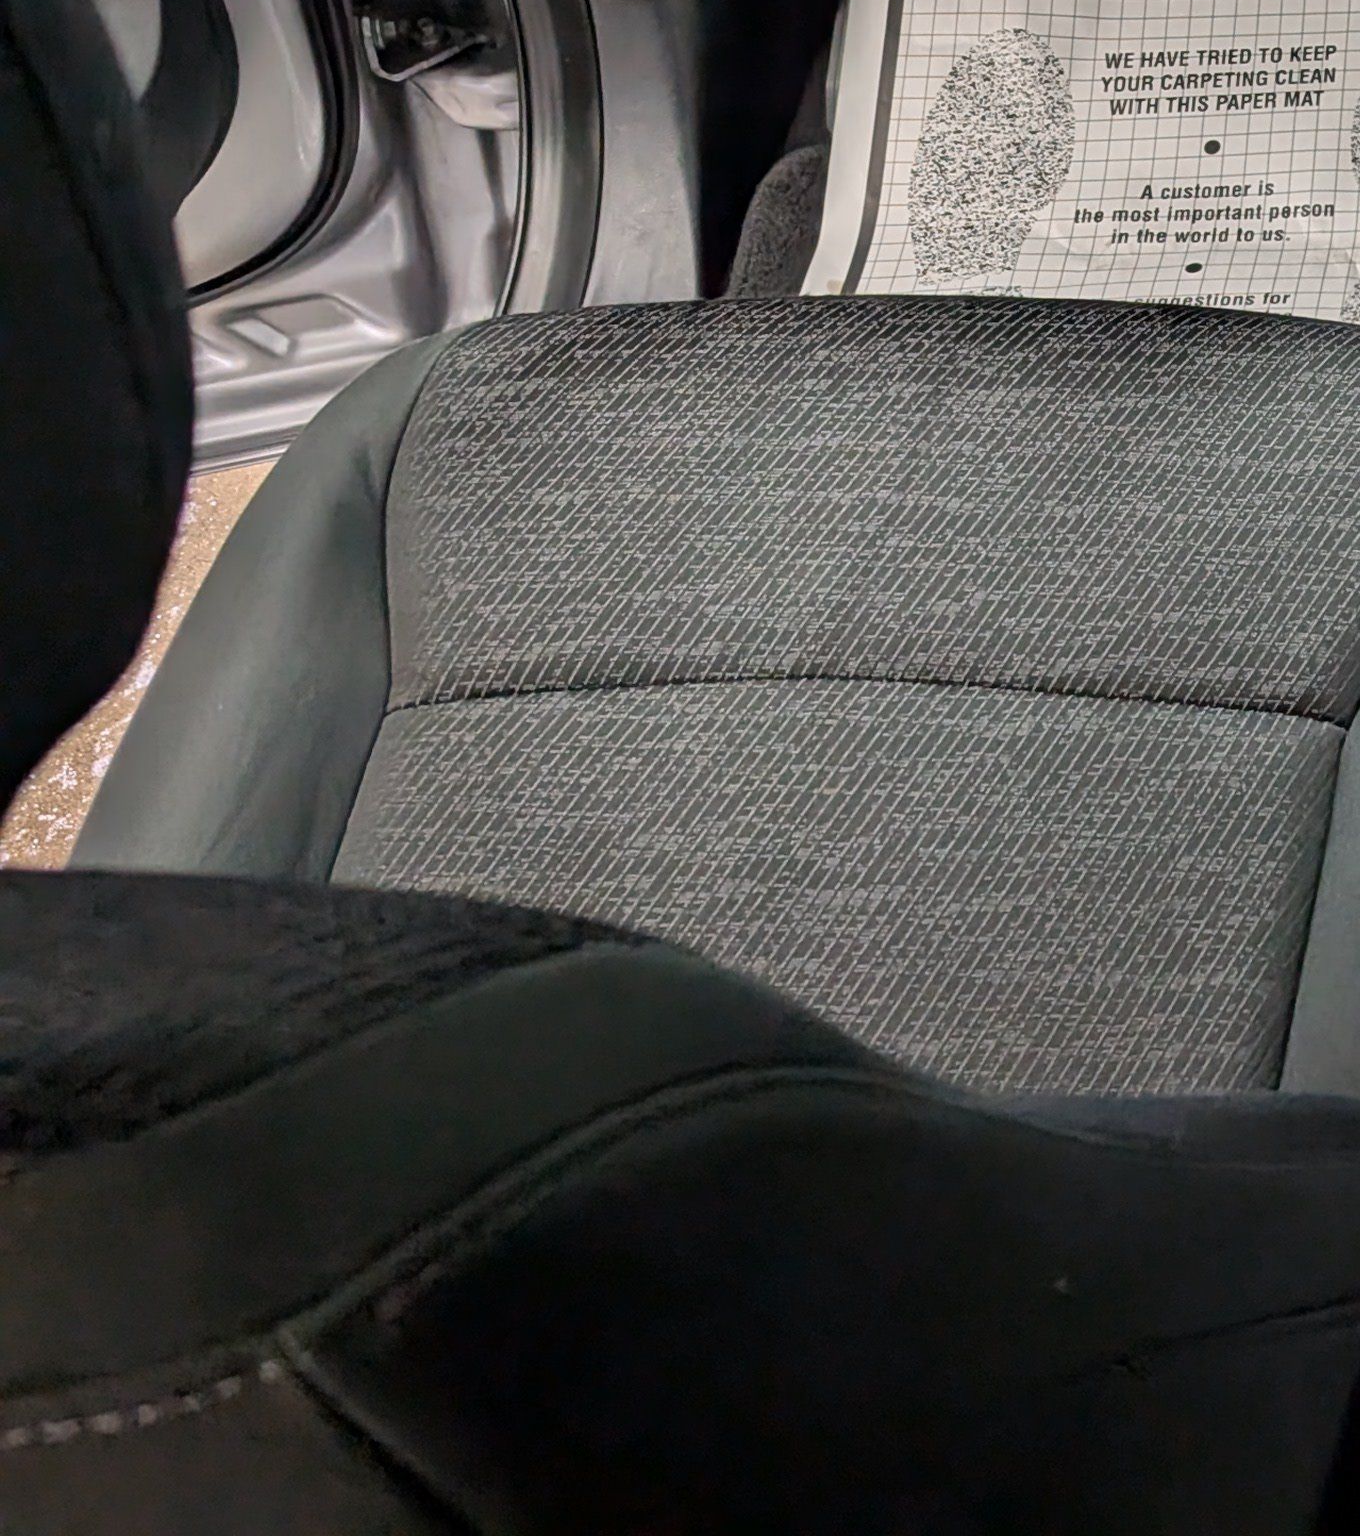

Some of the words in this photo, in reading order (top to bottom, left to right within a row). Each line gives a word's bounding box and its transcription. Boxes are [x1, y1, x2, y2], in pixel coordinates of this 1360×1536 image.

[1105, 52, 1134, 69] WE
[1140, 50, 1190, 68] HAVE
[1196, 48, 1251, 66] TRIED
[1258, 47, 1282, 64] TO
[1289, 45, 1337, 62] KEEP
[1101, 75, 1154, 93] YOUR
[1160, 70, 1268, 91] CARPETING
[1275, 67, 1336, 86] CLEAN
[1109, 98, 1158, 115] WITH
[1166, 95, 1209, 113] THIS
[1216, 92, 1276, 111] PAPER
[1284, 90, 1324, 107] MAT
[1140, 184, 1153, 200] A
[1161, 183, 1251, 200] customer
[1258, 180, 1274, 196] is
[1074, 208, 1104, 224] the
[1112, 207, 1159, 222] most
[1167, 204, 1262, 224] important
[1268, 203, 1335, 222] person
[1111, 228, 1128, 244] in
[1137, 228, 1167, 243] the
[1175, 227, 1229, 243] world
[1236, 228, 1254, 242] to
[1262, 228, 1291, 242] us.
[1262, 291, 1291, 305] for
